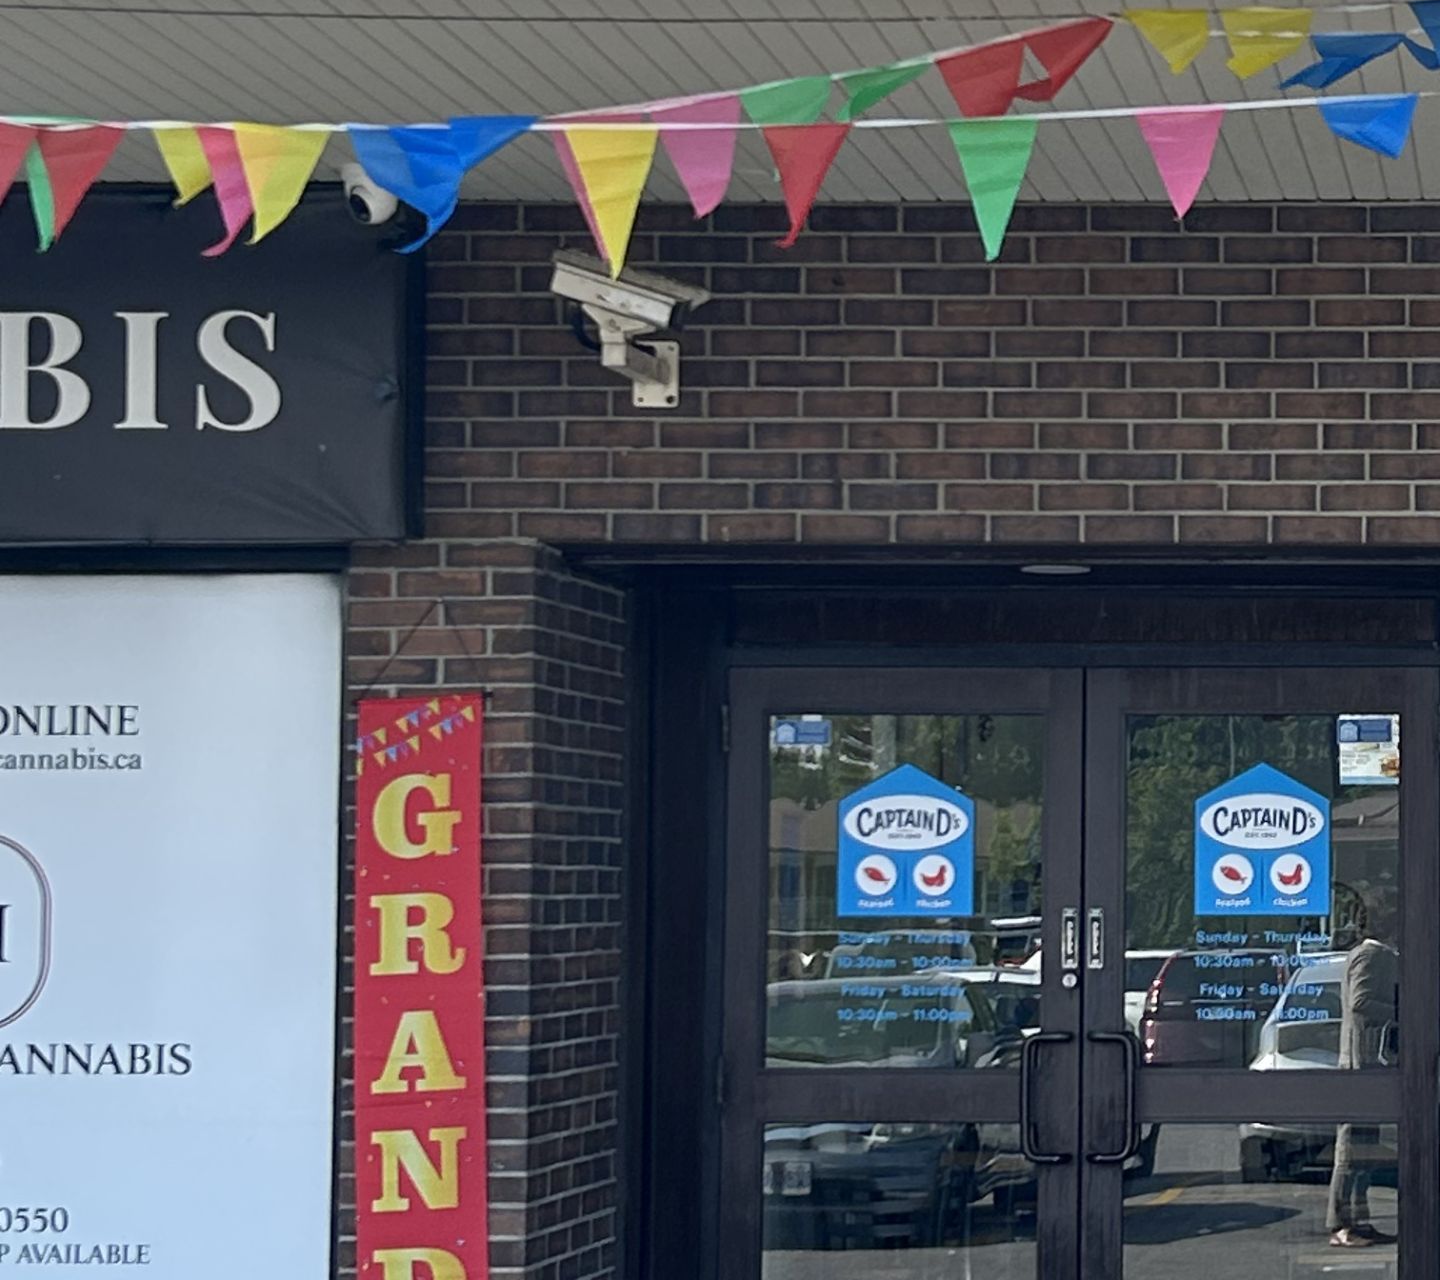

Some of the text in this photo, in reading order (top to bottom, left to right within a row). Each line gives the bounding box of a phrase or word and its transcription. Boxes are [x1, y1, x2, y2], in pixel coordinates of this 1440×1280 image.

[0, 309, 282, 432] BIS
[838, 931, 890, 945] Sunday
[907, 931, 971, 945] Thursday
[1195, 930, 1248, 944] Sunday
[841, 985, 886, 997] Friday
[901, 985, 966, 997] Saturday
[1200, 983, 1244, 997] Friday
[1274, 1007, 1329, 1021] 1:00pm
[0, 1042, 192, 1076] ANNABIS
[0, 1206, 69, 1233] 0550
[16, 1243, 150, 1265] AVAILABLE
